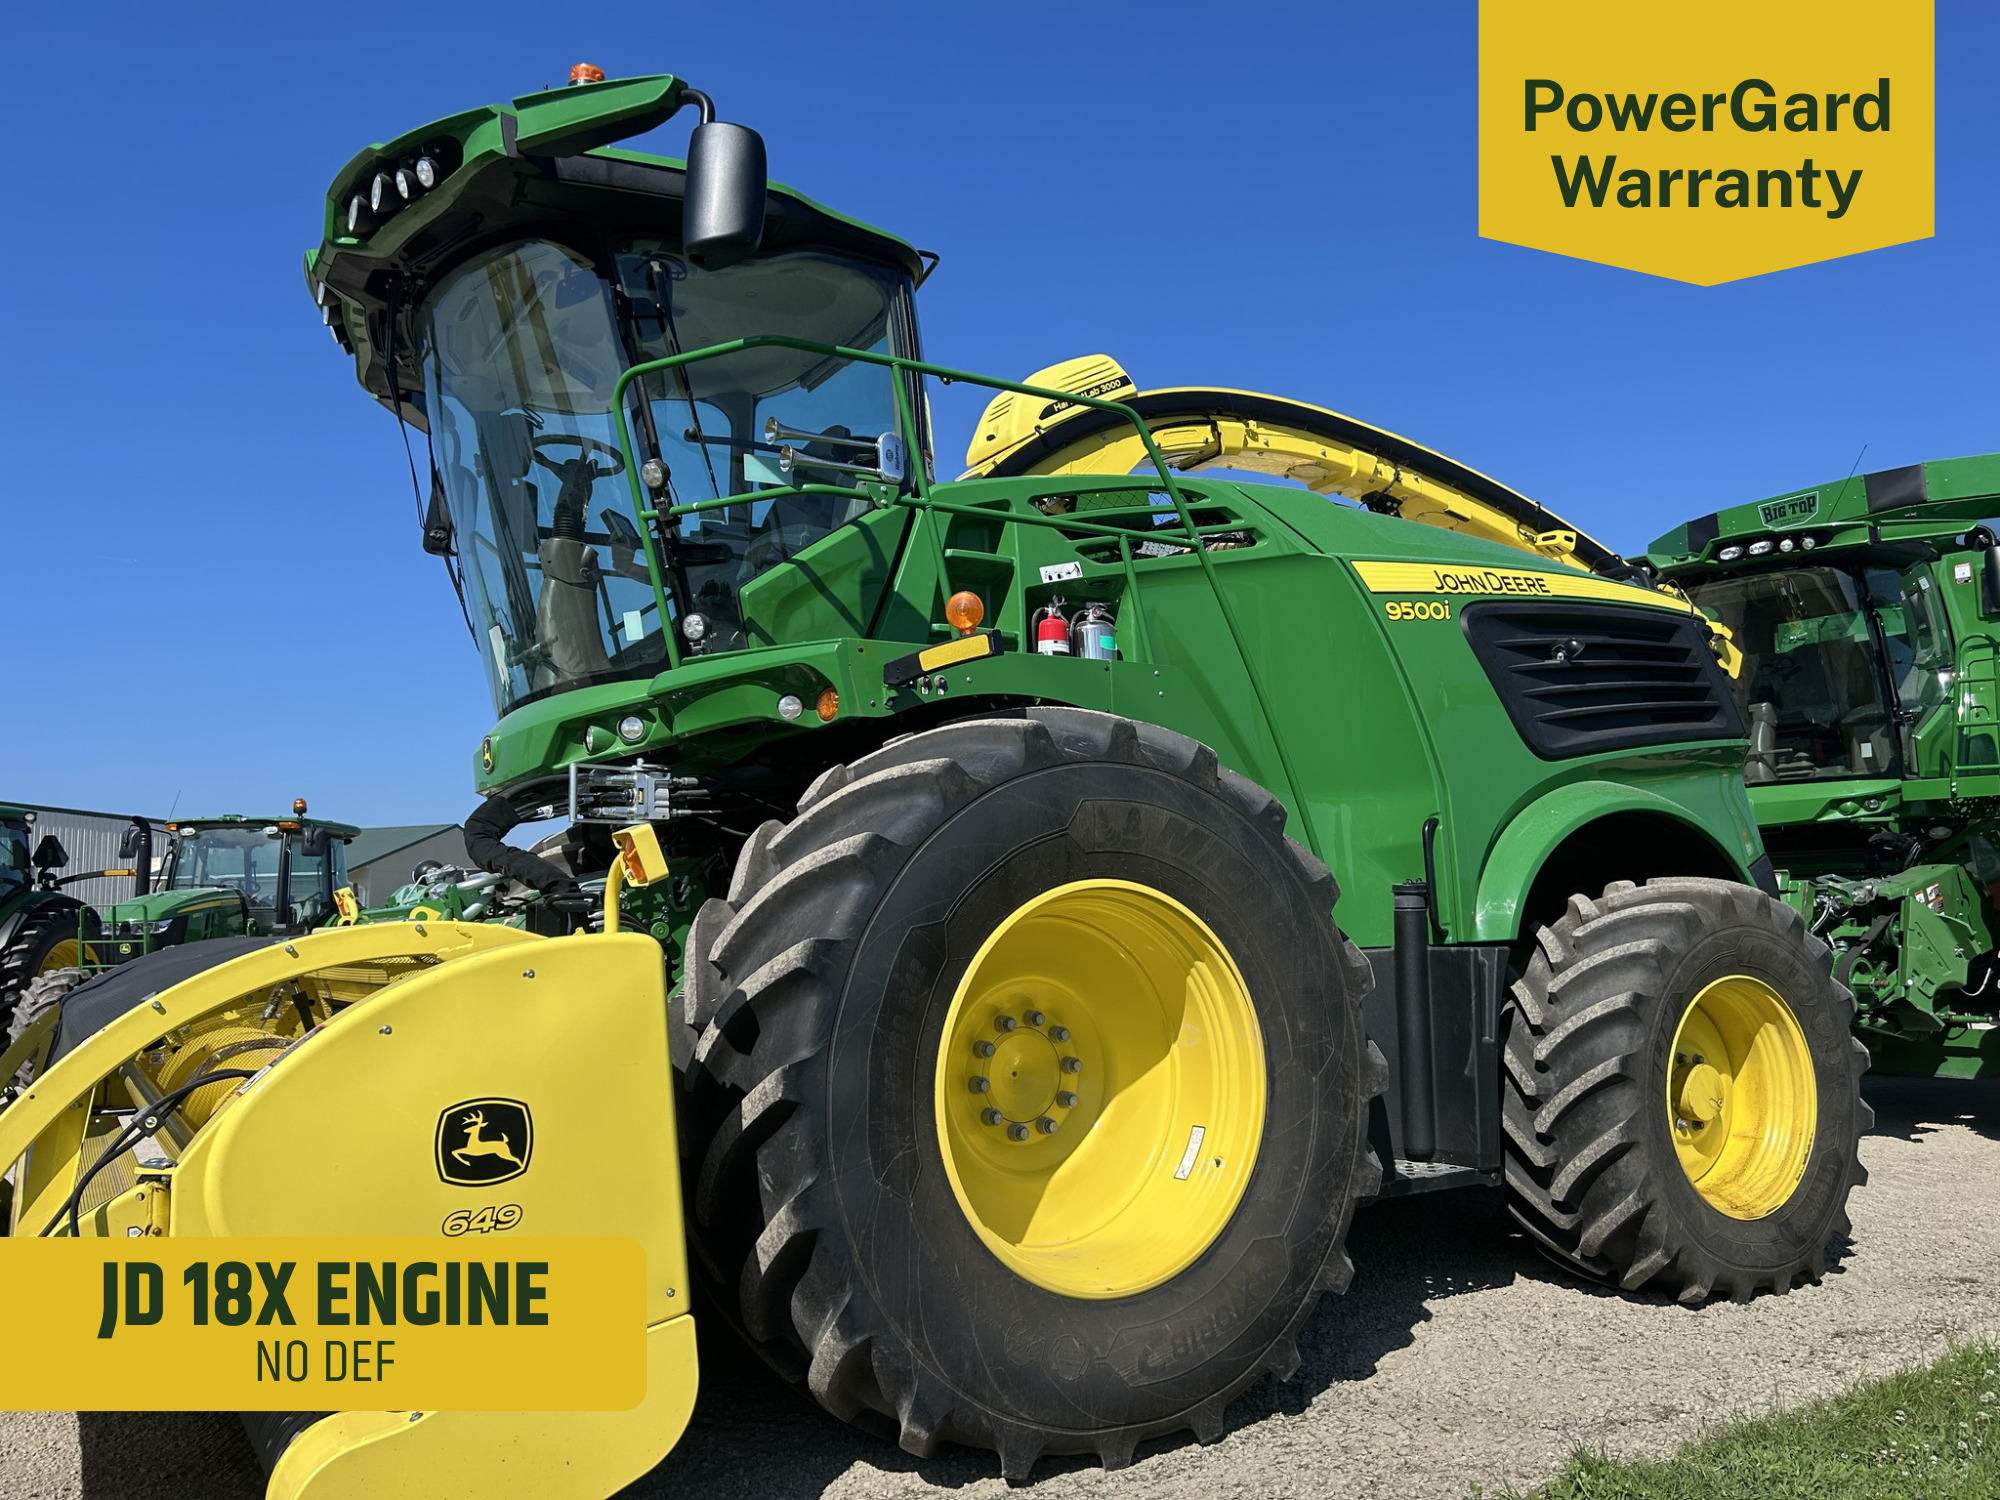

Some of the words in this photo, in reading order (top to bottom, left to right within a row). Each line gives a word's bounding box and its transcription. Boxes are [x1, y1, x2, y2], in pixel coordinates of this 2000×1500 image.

[1100, 378, 1122, 393] 3000
[1762, 505, 1787, 524] BIG
[1788, 495, 1816, 515] TOP
[1433, 570, 1488, 591] JOHN
[1483, 571, 1552, 594] DEERE
[1385, 598, 1452, 621] 9500i
[441, 1203, 524, 1237] 649
